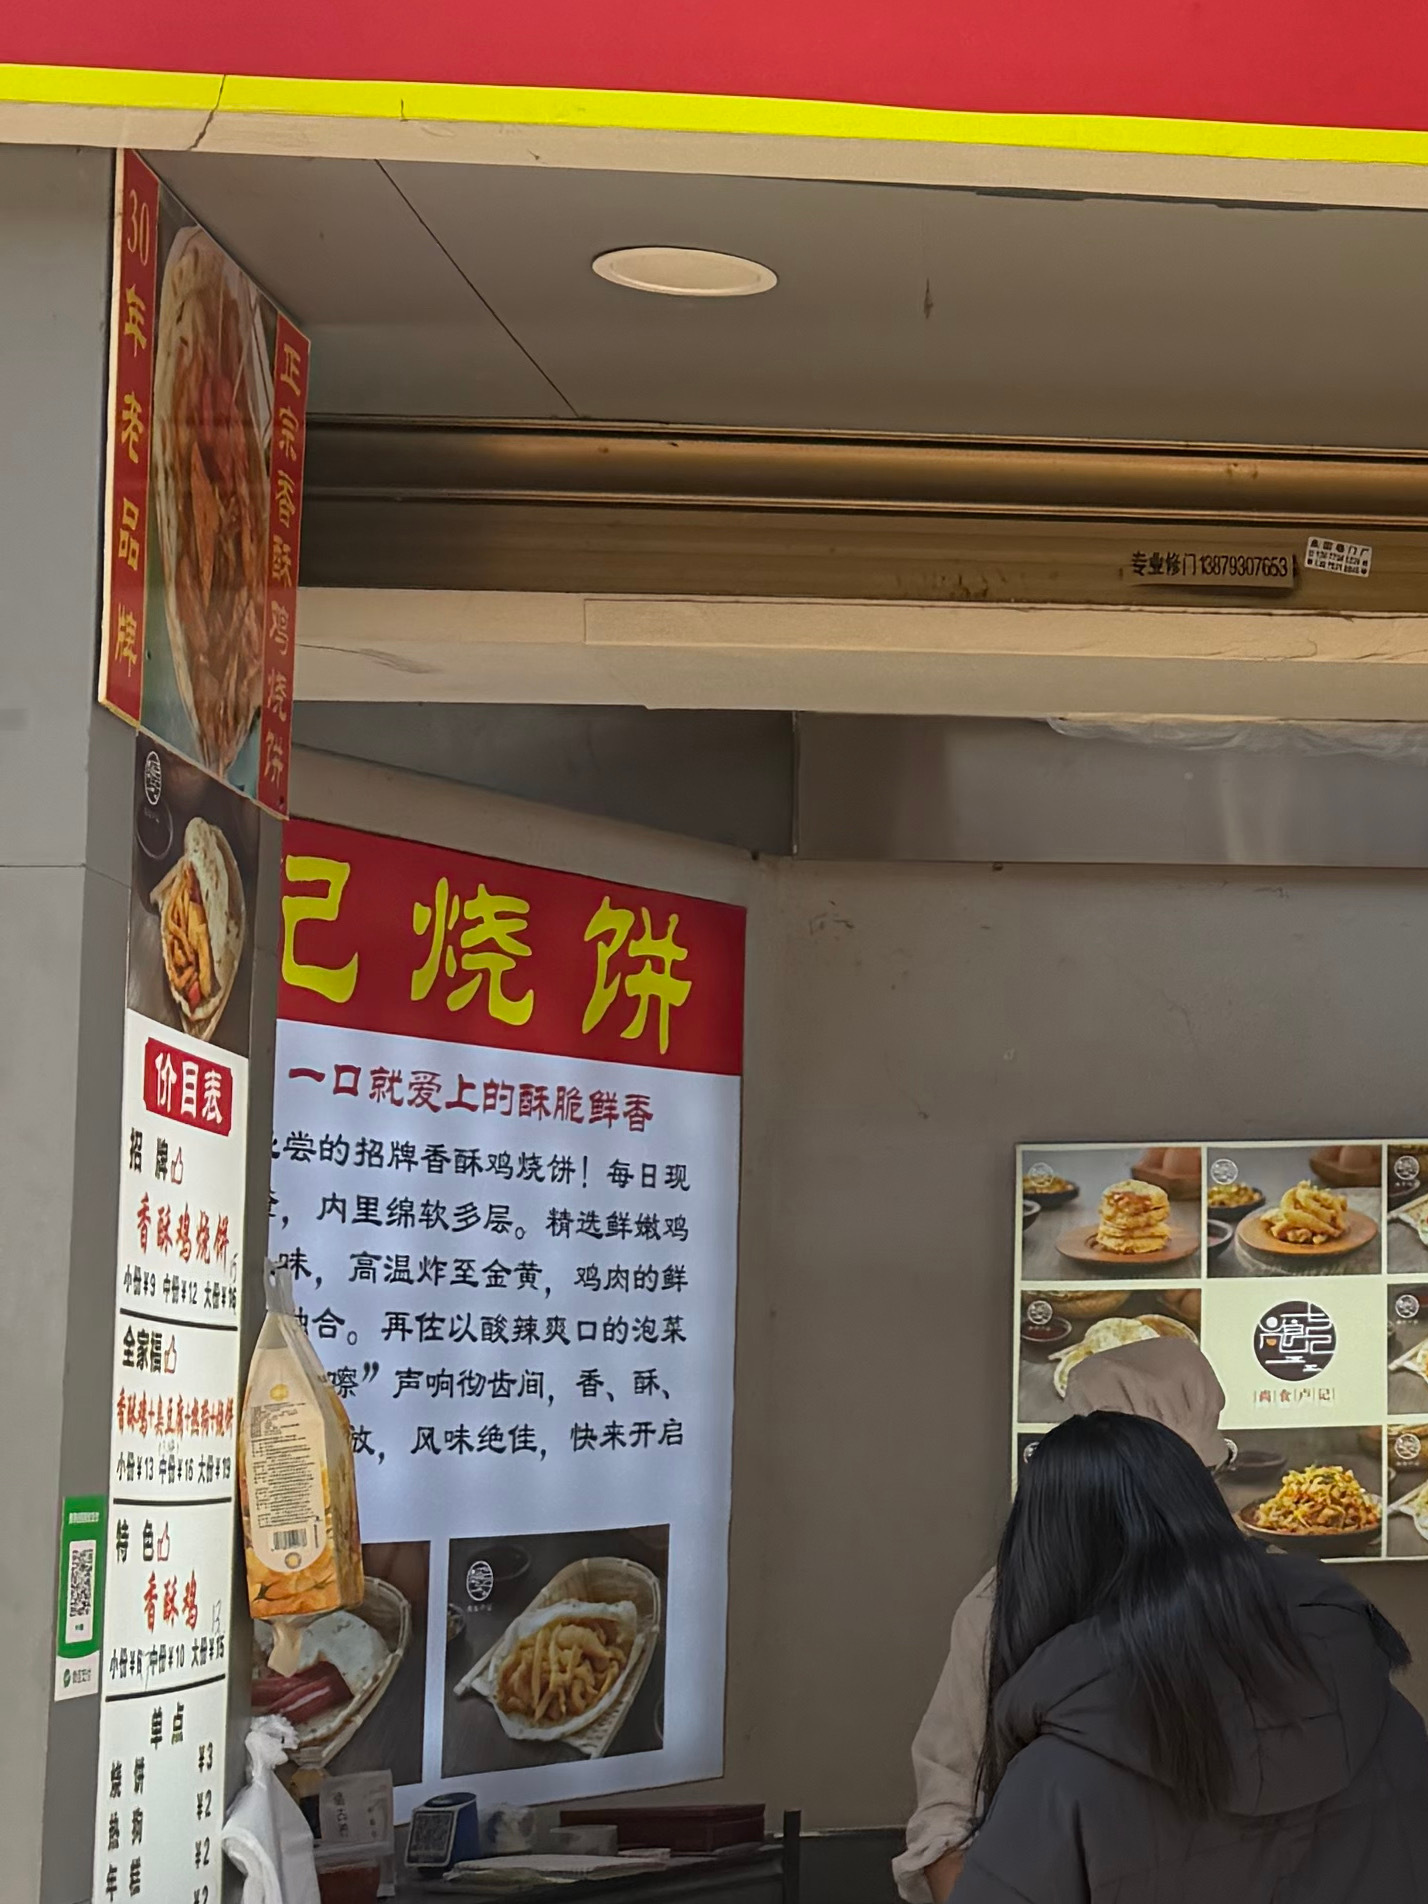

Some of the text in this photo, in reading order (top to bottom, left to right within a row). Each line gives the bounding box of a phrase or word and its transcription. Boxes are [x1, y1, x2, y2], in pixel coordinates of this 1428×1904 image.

[114, 189, 151, 675] 30年老品牌
[154, 1052, 223, 1124] 价目表
[288, 1064, 654, 1133] 一口就爱上的酥脆鲜香
[271, 1129, 691, 1192] 尝的招牌香酥鸡烧饼！每日现
[143, 1569, 199, 1634] 香酥鸡
[150, 1701, 184, 1750] 单点
